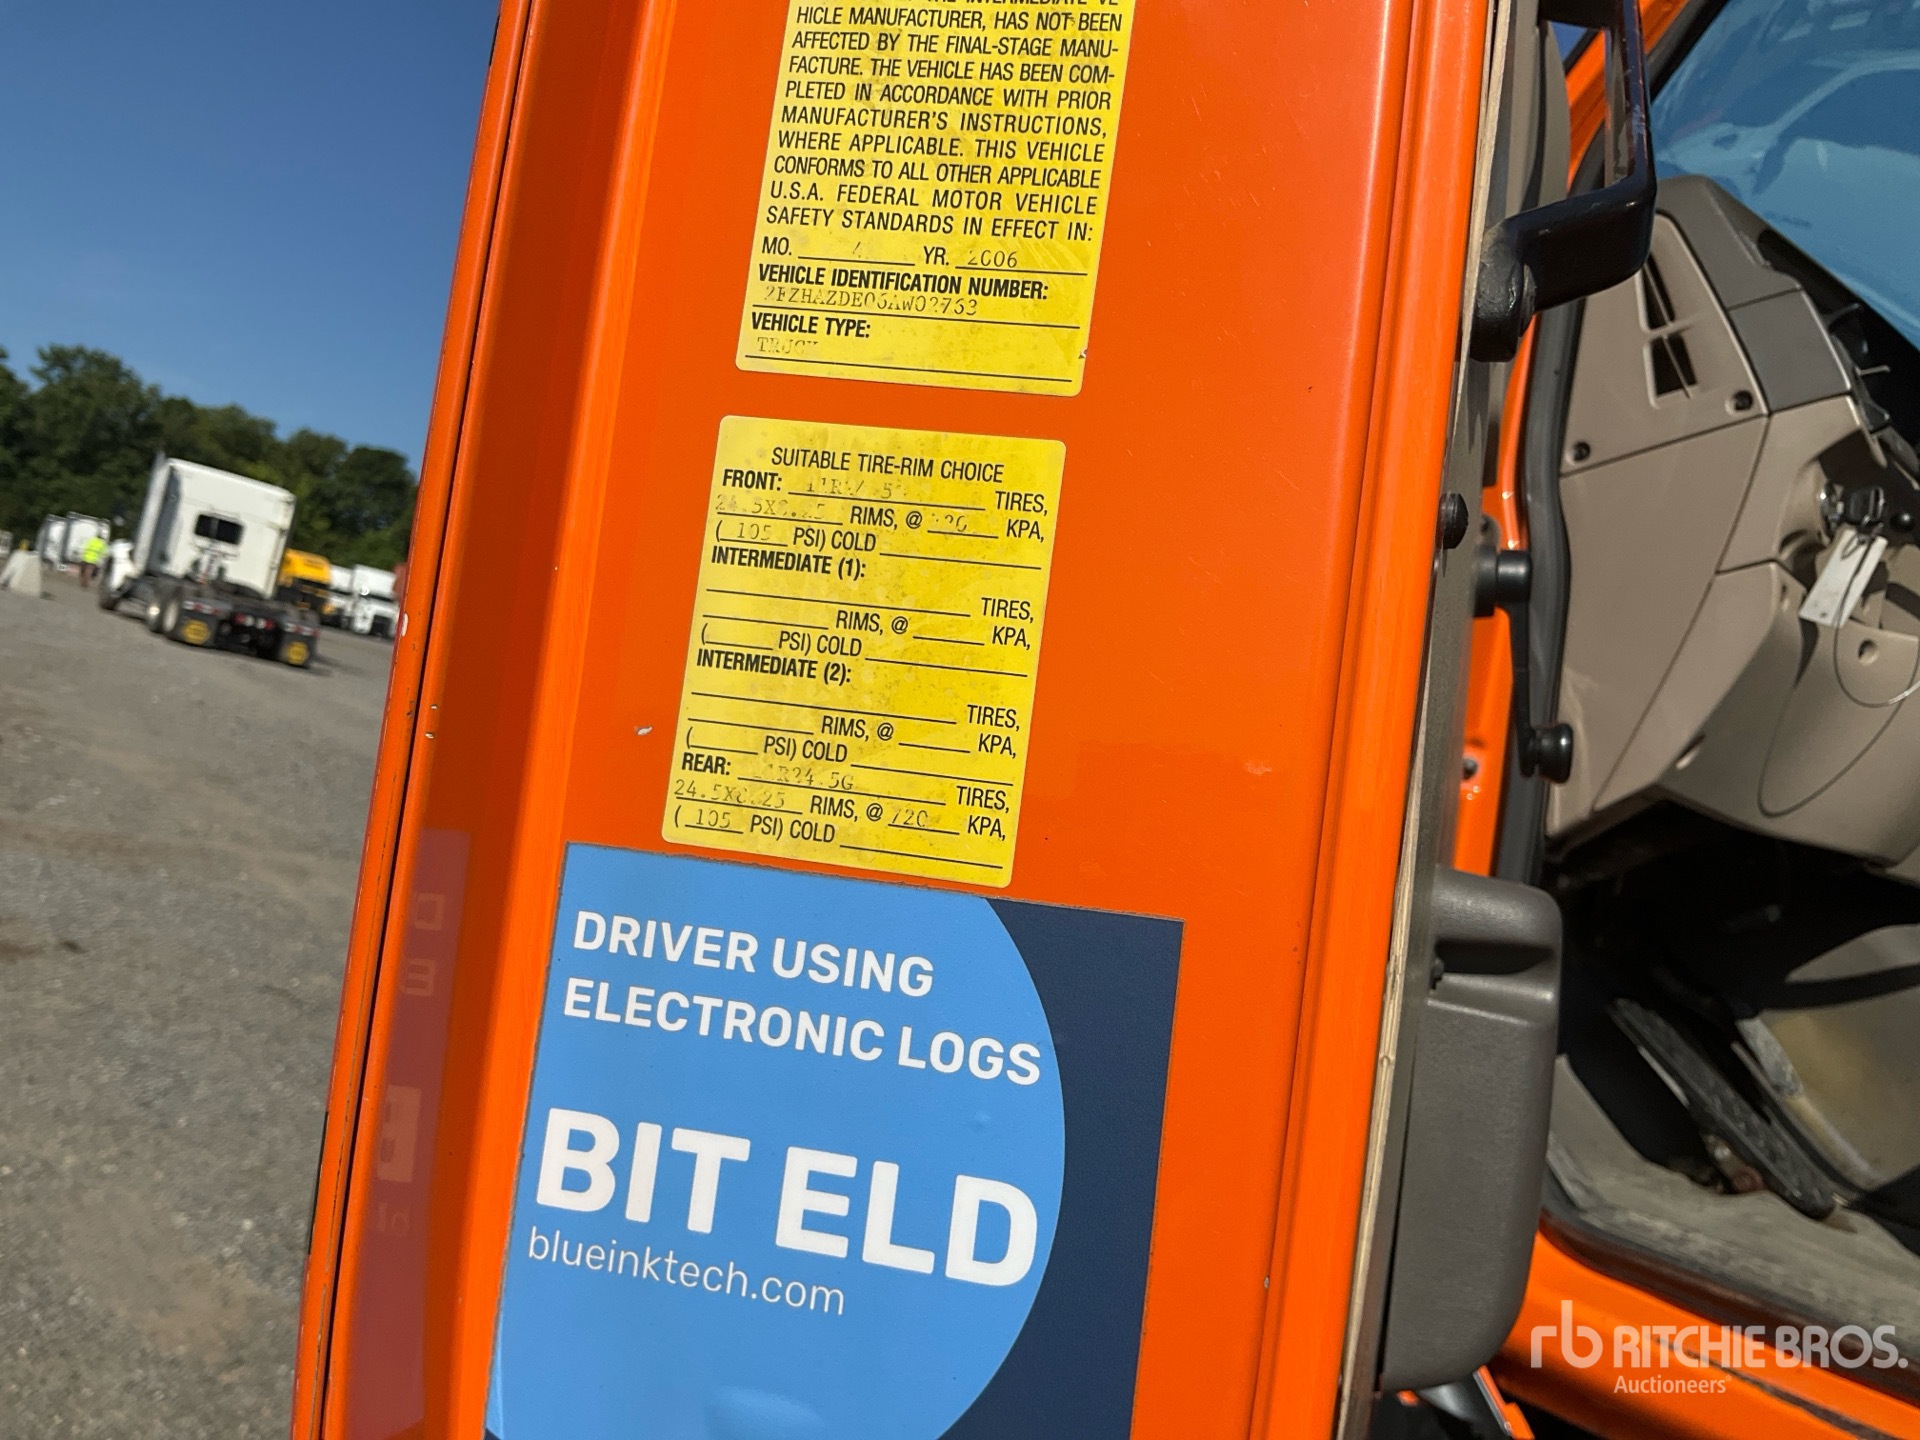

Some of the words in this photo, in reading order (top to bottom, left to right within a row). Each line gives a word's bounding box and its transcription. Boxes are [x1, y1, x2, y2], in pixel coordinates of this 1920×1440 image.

[797, 7, 843, 24] HICLE
[849, 7, 985, 31] MANUFACTURER,
[994, 12, 1029, 30] HAS
[1036, 12, 1072, 30] NOT
[1078, 13, 1122, 31] BEEN
[792, 31, 869, 50] AFFECTED
[878, 33, 900, 51] BY
[908, 34, 939, 52] THE
[946, 36, 1052, 56] FINAL-STAGE
[1060, 39, 1118, 58] MANU-
[789, 56, 862, 75] FACTURE.
[871, 58, 902, 76] THE
[908, 60, 974, 79] VEHICLE
[980, 62, 1014, 81] HAS
[1020, 63, 1063, 82] BEEN
[1069, 65, 1114, 83] COM-
[786, 81, 845, 99] PLETED
[855, 83, 872, 101] IN
[880, 84, 994, 106] ACCORDANCE
[1004, 89, 1048, 107] WITH
[1057, 90, 1111, 109] PRIOR
[782, 106, 948, 130] MANUFACTURER'S
[961, 113, 1106, 138] INSTRUCTIONS,
[779, 130, 841, 150] WHERE
[849, 134, 963, 156] APPLICABLE.
[975, 139, 1016, 159] THIS
[1027, 141, 1104, 162] VEHICLE
[774, 155, 865, 177] CONFORMS
[872, 160, 892, 179] TO
[898, 162, 929, 180] ALL
[937, 163, 991, 184] OTHER
[997, 167, 1101, 188] APPLICABLE
[771, 181, 823, 201] U.S.A.
[837, 184, 919, 206] FEDERAL
[932, 189, 1001, 210] MOTOR
[1016, 193, 1097, 214] VEHICLE
[767, 206, 834, 226] SAFETY
[842, 210, 953, 234] STANDARDS
[964, 217, 982, 235] IN
[992, 218, 1059, 239] EFFECT
[1068, 222, 1092, 241] IN:
[762, 236, 791, 255] MO.
[924, 246, 949, 265] YR.
[759, 264, 826, 285] VEHICLE
[831, 269, 962, 294] IDENTIFICATION
[968, 277, 1048, 299] NUMBER:
[752, 312, 819, 334] VEHICLE
[825, 317, 870, 338] TYPE:
[772, 447, 851, 470] SUITABLE
[858, 454, 934, 477] TIRE-RIM
[941, 460, 1004, 483] CHOICE
[723, 469, 782, 491] FRONT:
[995, 491, 1047, 516] TIRES,
[793, 527, 825, 552] PSI)
[831, 530, 876, 551] COLD
[850, 506, 897, 530] RIMS,
[906, 511, 922, 529] @
[1007, 519, 1044, 542] KPA,
[712, 546, 832, 574] INTERMEDIATE
[838, 557, 866, 581] (1):
[981, 597, 1033, 623] TIRES,
[779, 631, 811, 656] PSI)
[817, 635, 862, 656] COLD
[836, 610, 883, 635] RIMS,
[891, 616, 908, 634] @
[992, 626, 1030, 650] KPA,
[697, 649, 818, 679] INTERMEDIATE
[824, 662, 851, 686] (2):
[967, 704, 1019, 731] TIRES,
[764, 735, 796, 761] PSI)
[802, 740, 847, 762] COLD
[821, 715, 869, 741] RIMS,
[877, 722, 893, 741] @
[978, 733, 1016, 758] KPA,
[682, 752, 731, 775] REAR:
[957, 786, 1009, 813] TIRES,
[750, 815, 783, 840] PSI)
[790, 820, 835, 843] COLD
[810, 795, 857, 822] RIMS,
[866, 803, 883, 821] @
[968, 815, 1005, 841] KPA,
[574, 911, 758, 972] DRIVER
[773, 938, 933, 996] USING
[564, 978, 884, 1060] ELECTRONIC
[899, 1027, 1040, 1085] LOGS
[536, 1108, 750, 1233] BIT
[774, 1147, 1037, 1287] ELD
[529, 1227, 848, 1314] blueinktech.com
